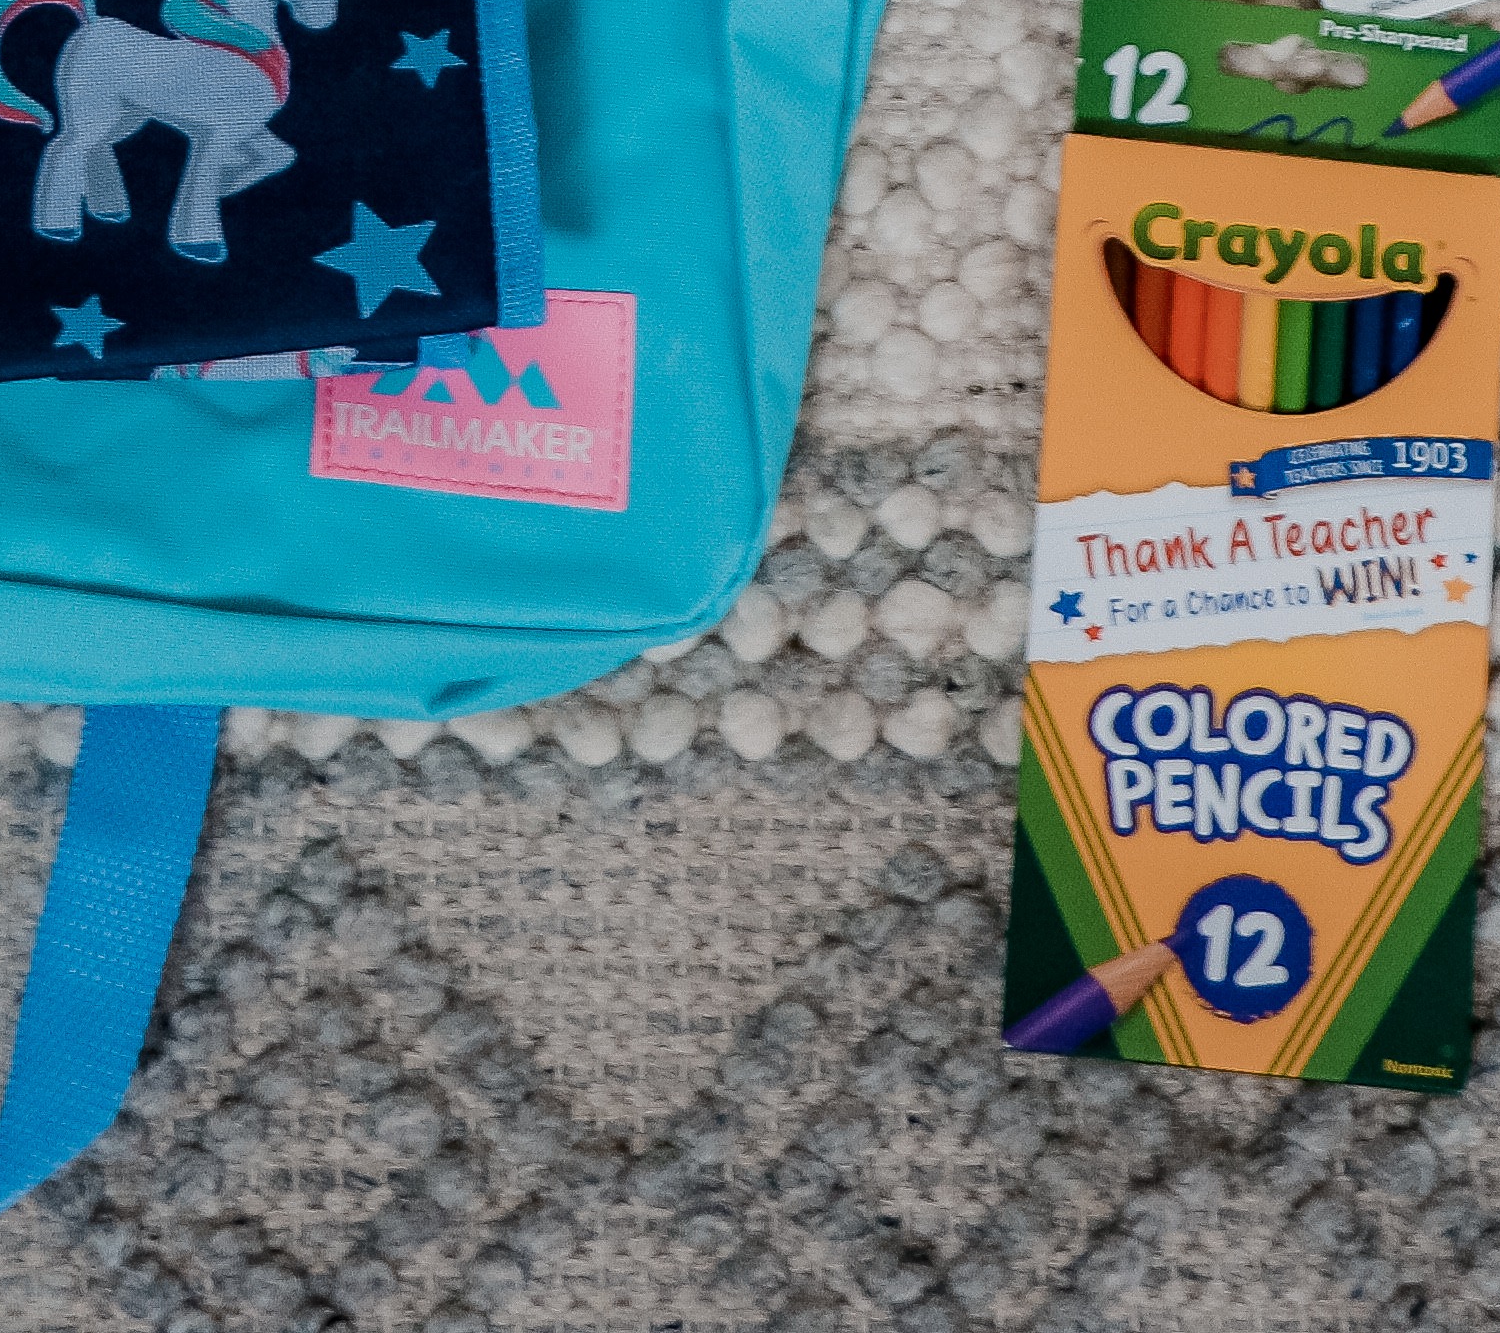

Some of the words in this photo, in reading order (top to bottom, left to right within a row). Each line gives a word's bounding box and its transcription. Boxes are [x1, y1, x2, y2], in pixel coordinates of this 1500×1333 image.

[1319, 19, 1468, 53] Pre-Sharpened
[1104, 44, 1191, 124] 12
[1132, 203, 1425, 284] Crayola
[333, 400, 597, 464] TRAILMAKER
[1392, 442, 1469, 474] 1903
[1077, 526, 1216, 579] Thank
[1230, 518, 1257, 565] A
[1262, 507, 1437, 559] Teacher
[1109, 596, 1154, 626] For
[1164, 598, 1179, 619] a
[1187, 585, 1276, 617] Chance
[1284, 582, 1311, 607] to
[1317, 555, 1421, 607] WIN!
[1092, 689, 1411, 778] COLORED
[1112, 760, 1390, 860] PENCILS
[1197, 904, 1290, 987] 12
